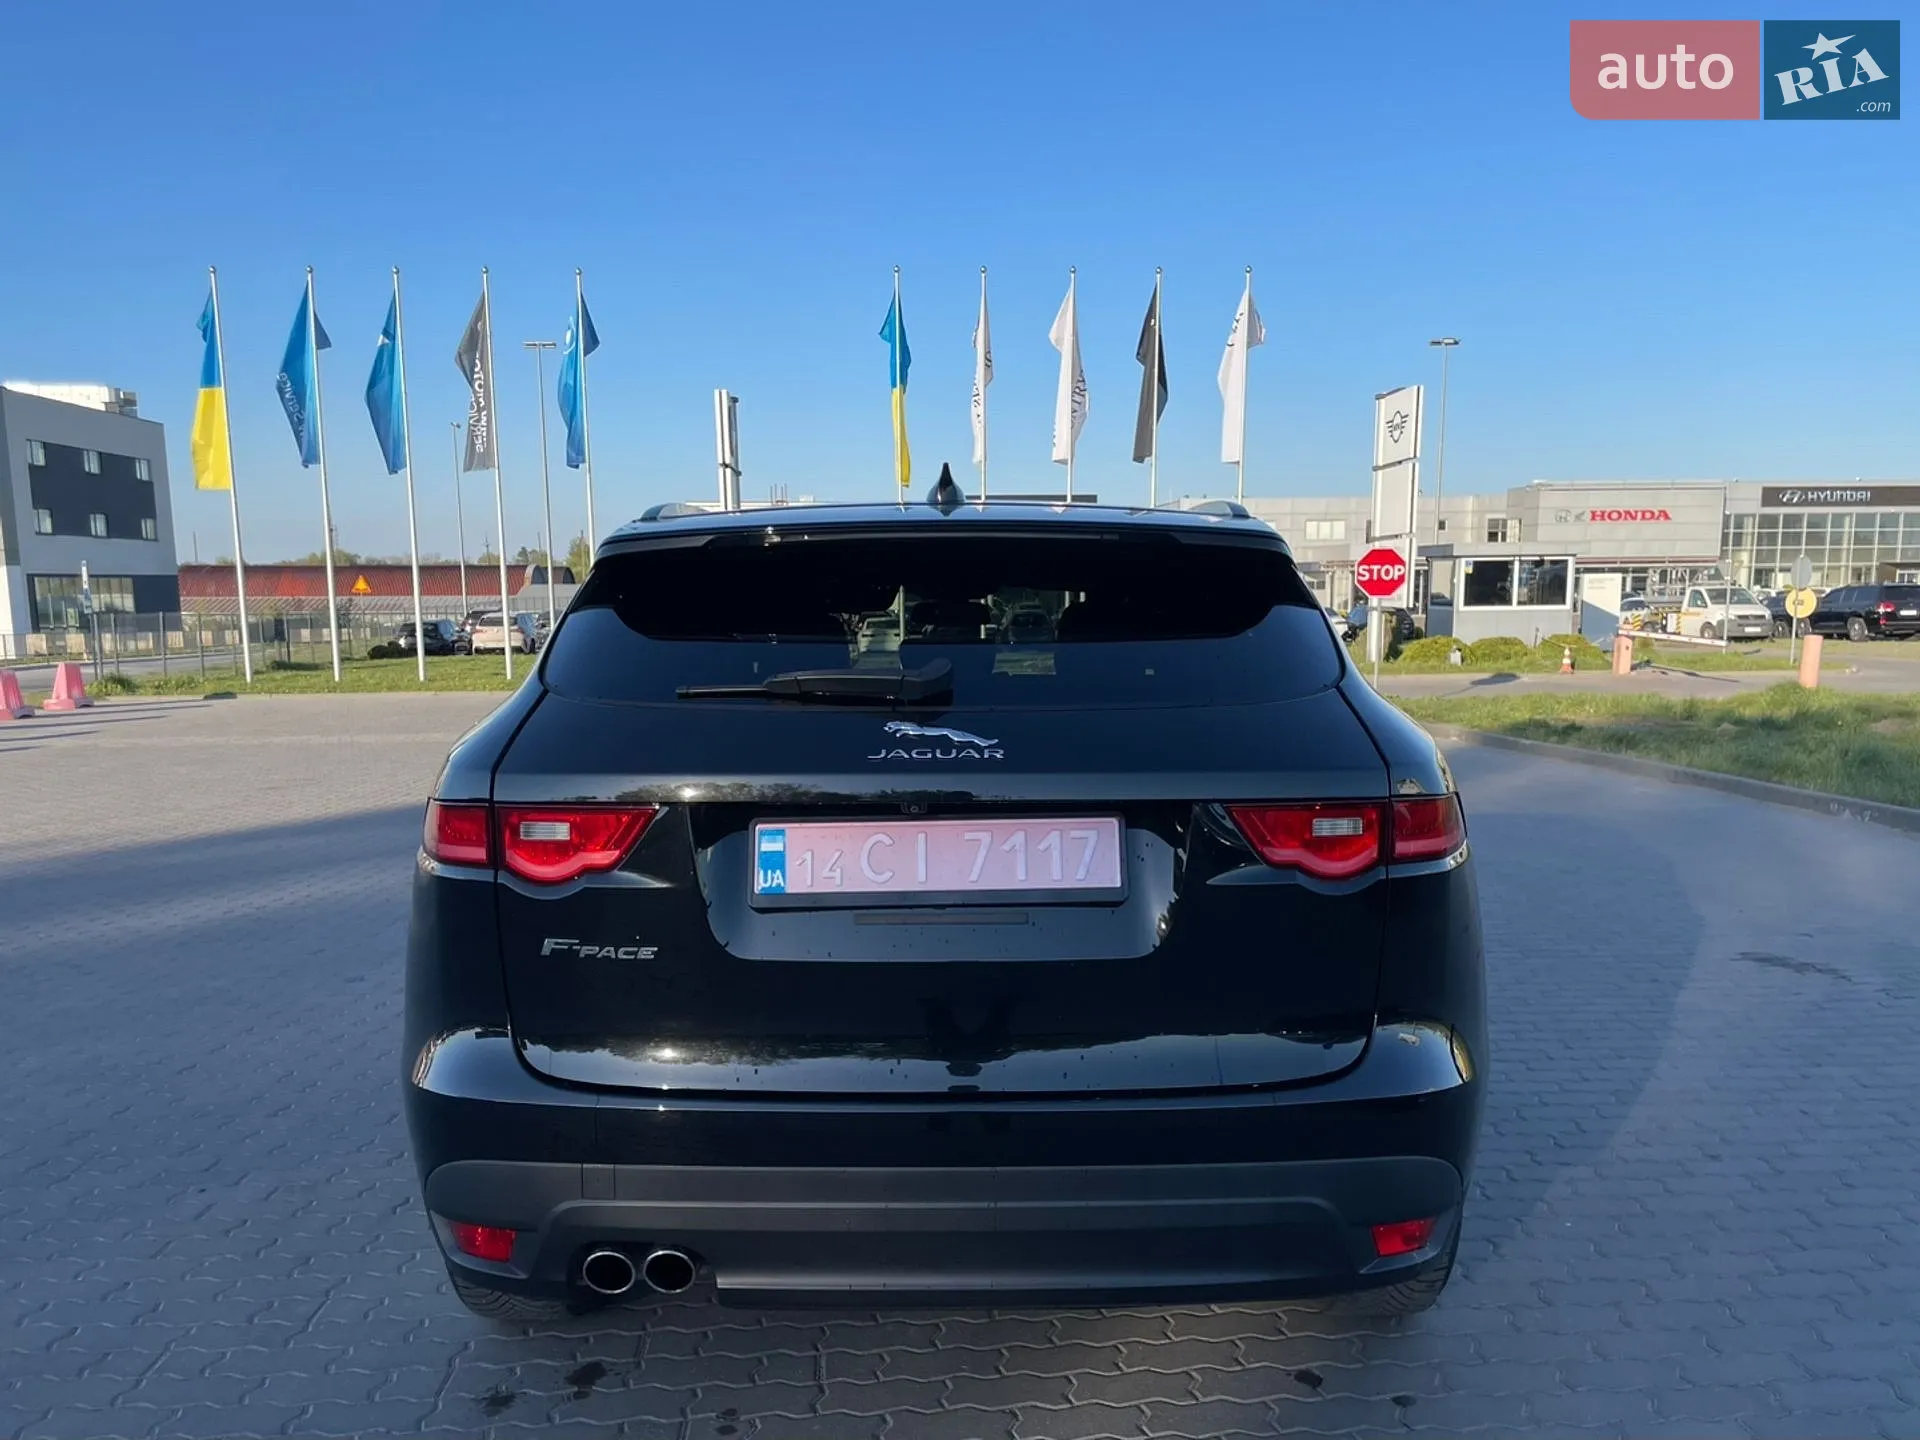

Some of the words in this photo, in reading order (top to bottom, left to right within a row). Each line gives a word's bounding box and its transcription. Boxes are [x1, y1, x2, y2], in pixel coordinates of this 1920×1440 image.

[1808, 490, 1871, 503] HYUNDAI
[1590, 509, 1672, 523] HONDA
[1356, 563, 1406, 583] STOP
[867, 748, 1004, 760] JAGUAR
[795, 849, 845, 888] 14
[963, 829, 1099, 884] 7117
[758, 868, 785, 890] UA
[541, 938, 659, 960] F-PACE
